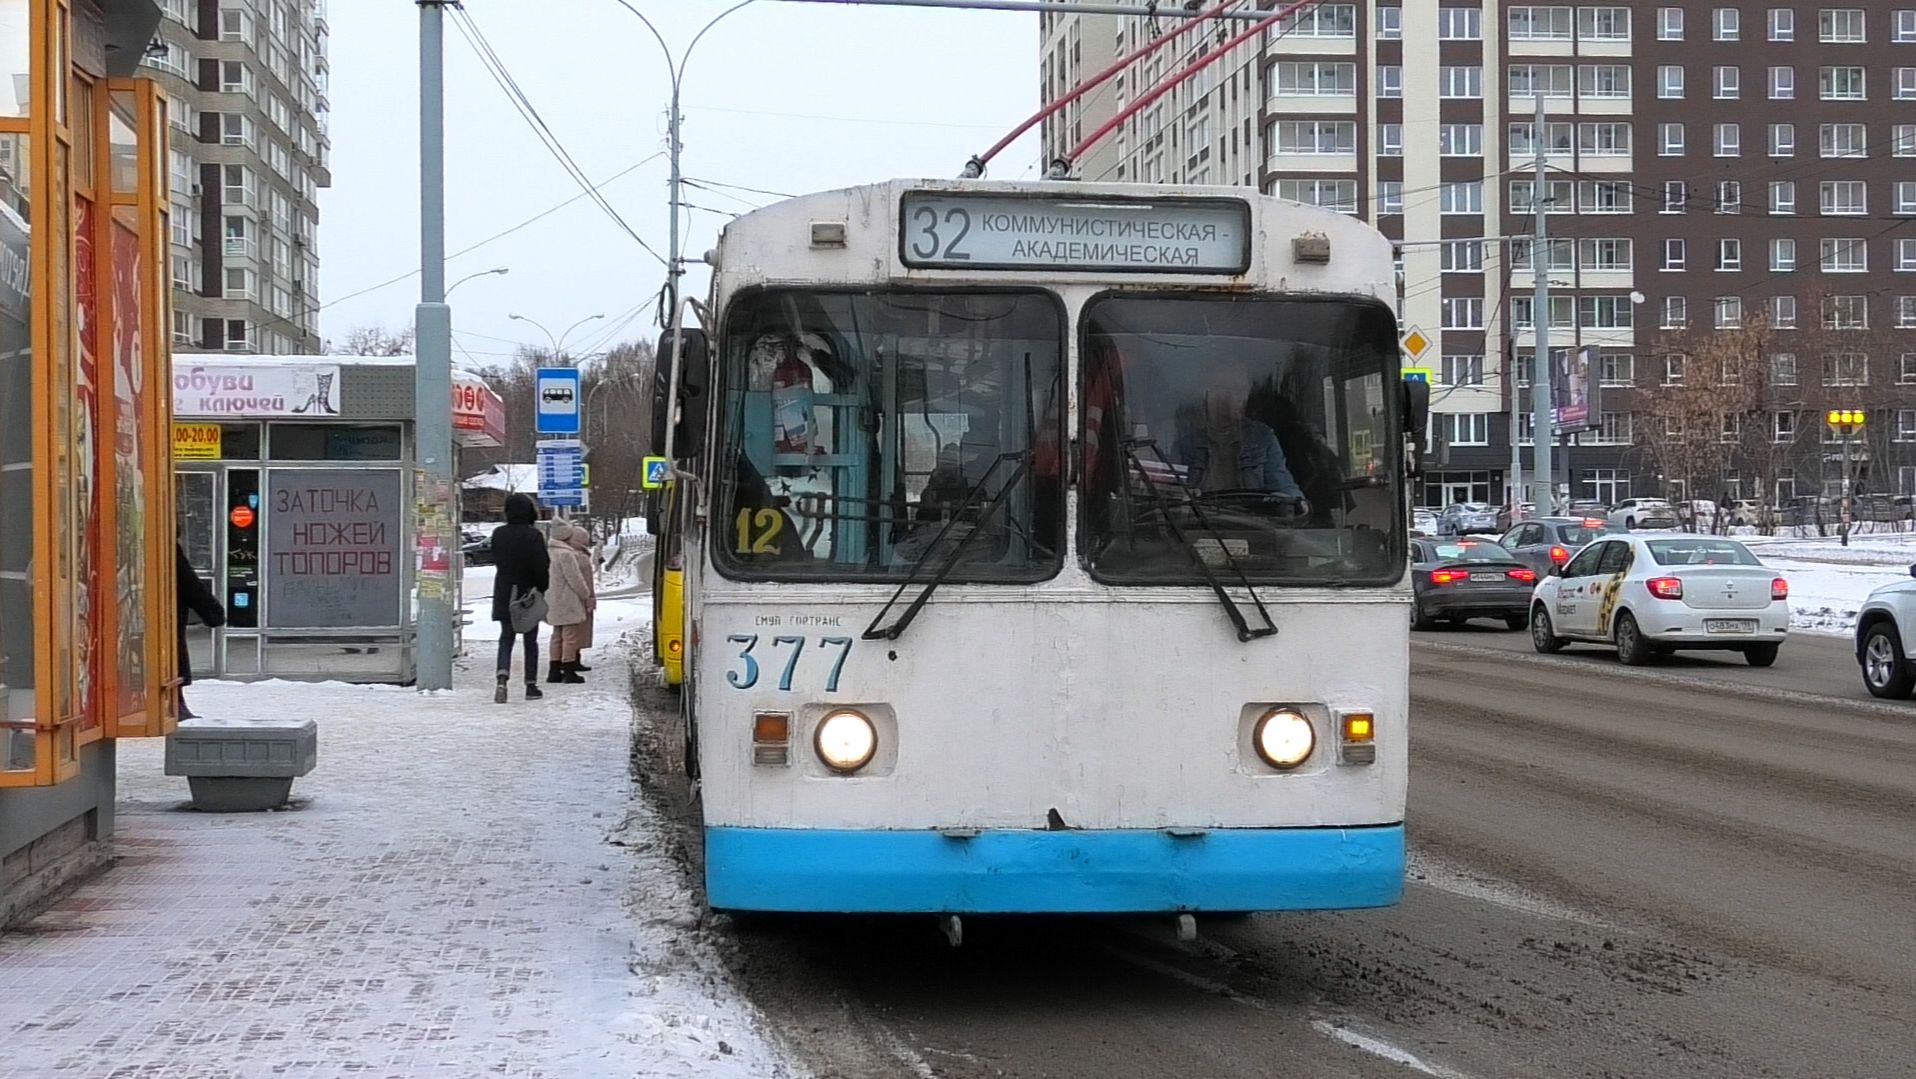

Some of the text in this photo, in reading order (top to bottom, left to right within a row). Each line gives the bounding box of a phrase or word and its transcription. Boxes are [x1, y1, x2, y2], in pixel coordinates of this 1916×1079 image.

[912, 206, 971, 261] 32
[982, 214, 1216, 242] КОММУНИСТИЧЕСКАЯ
[1012, 240, 1199, 266] АКАДЕМИЧЕСКАЯ
[175, 367, 253, 396] обуви
[200, 394, 284, 413] ключей
[277, 489, 379, 513] ЗАТОЧКА
[293, 520, 385, 545] НОЖЕЙ
[735, 508, 783, 554] 12
[273, 551, 391, 576] ТОПОРОВ
[755, 615, 841, 627] ЕМУП ГОРТРАНС
[726, 633, 853, 692] 377
